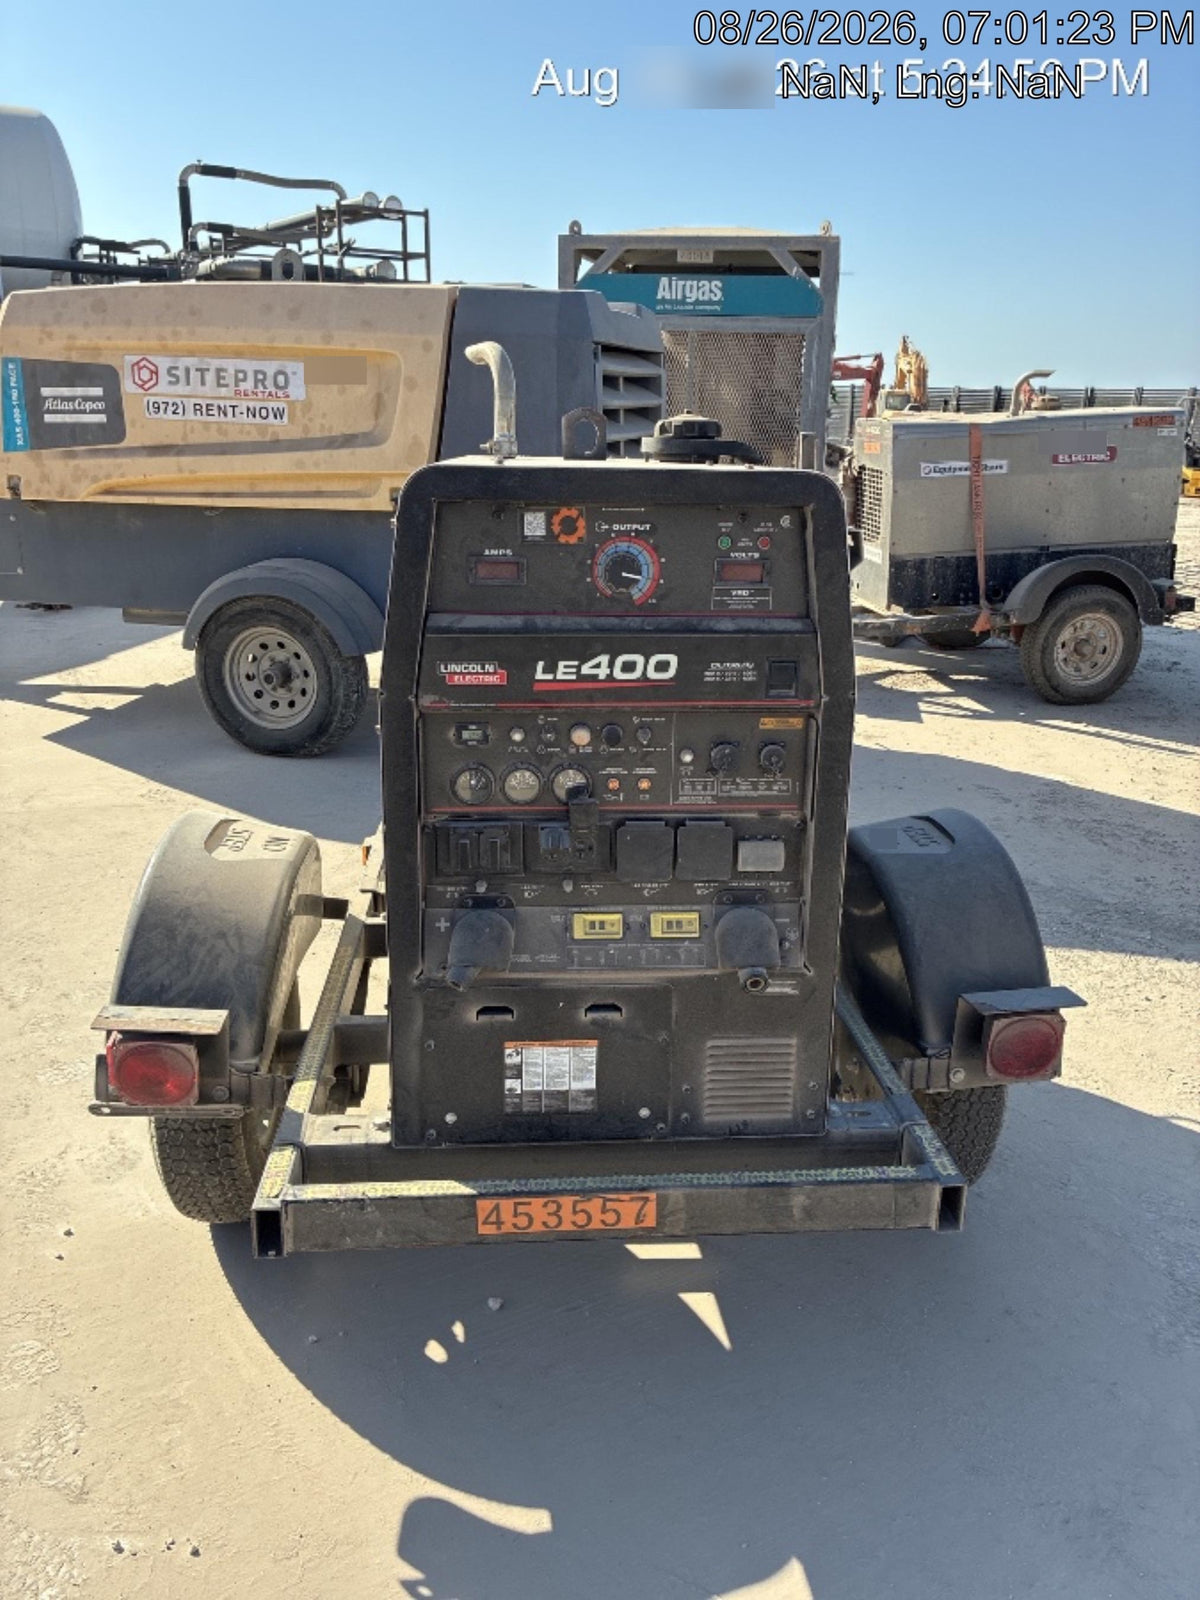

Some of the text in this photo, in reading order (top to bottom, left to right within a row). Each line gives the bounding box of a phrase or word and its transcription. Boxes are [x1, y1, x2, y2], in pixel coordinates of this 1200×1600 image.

[656, 276, 723, 303] Airgas
[166, 365, 291, 390] SITEPRO
[234, 389, 291, 399] RENTALS
[43, 398, 106, 414] Atlas Copco
[146, 401, 286, 421] (972) RENT-NOW
[483, 548, 513, 556] AMPS
[440, 664, 496, 673] LINCOLN
[534, 653, 679, 680] LE400
[454, 674, 501, 683] ELECTRIC
[481, 1195, 650, 1232] 453557
